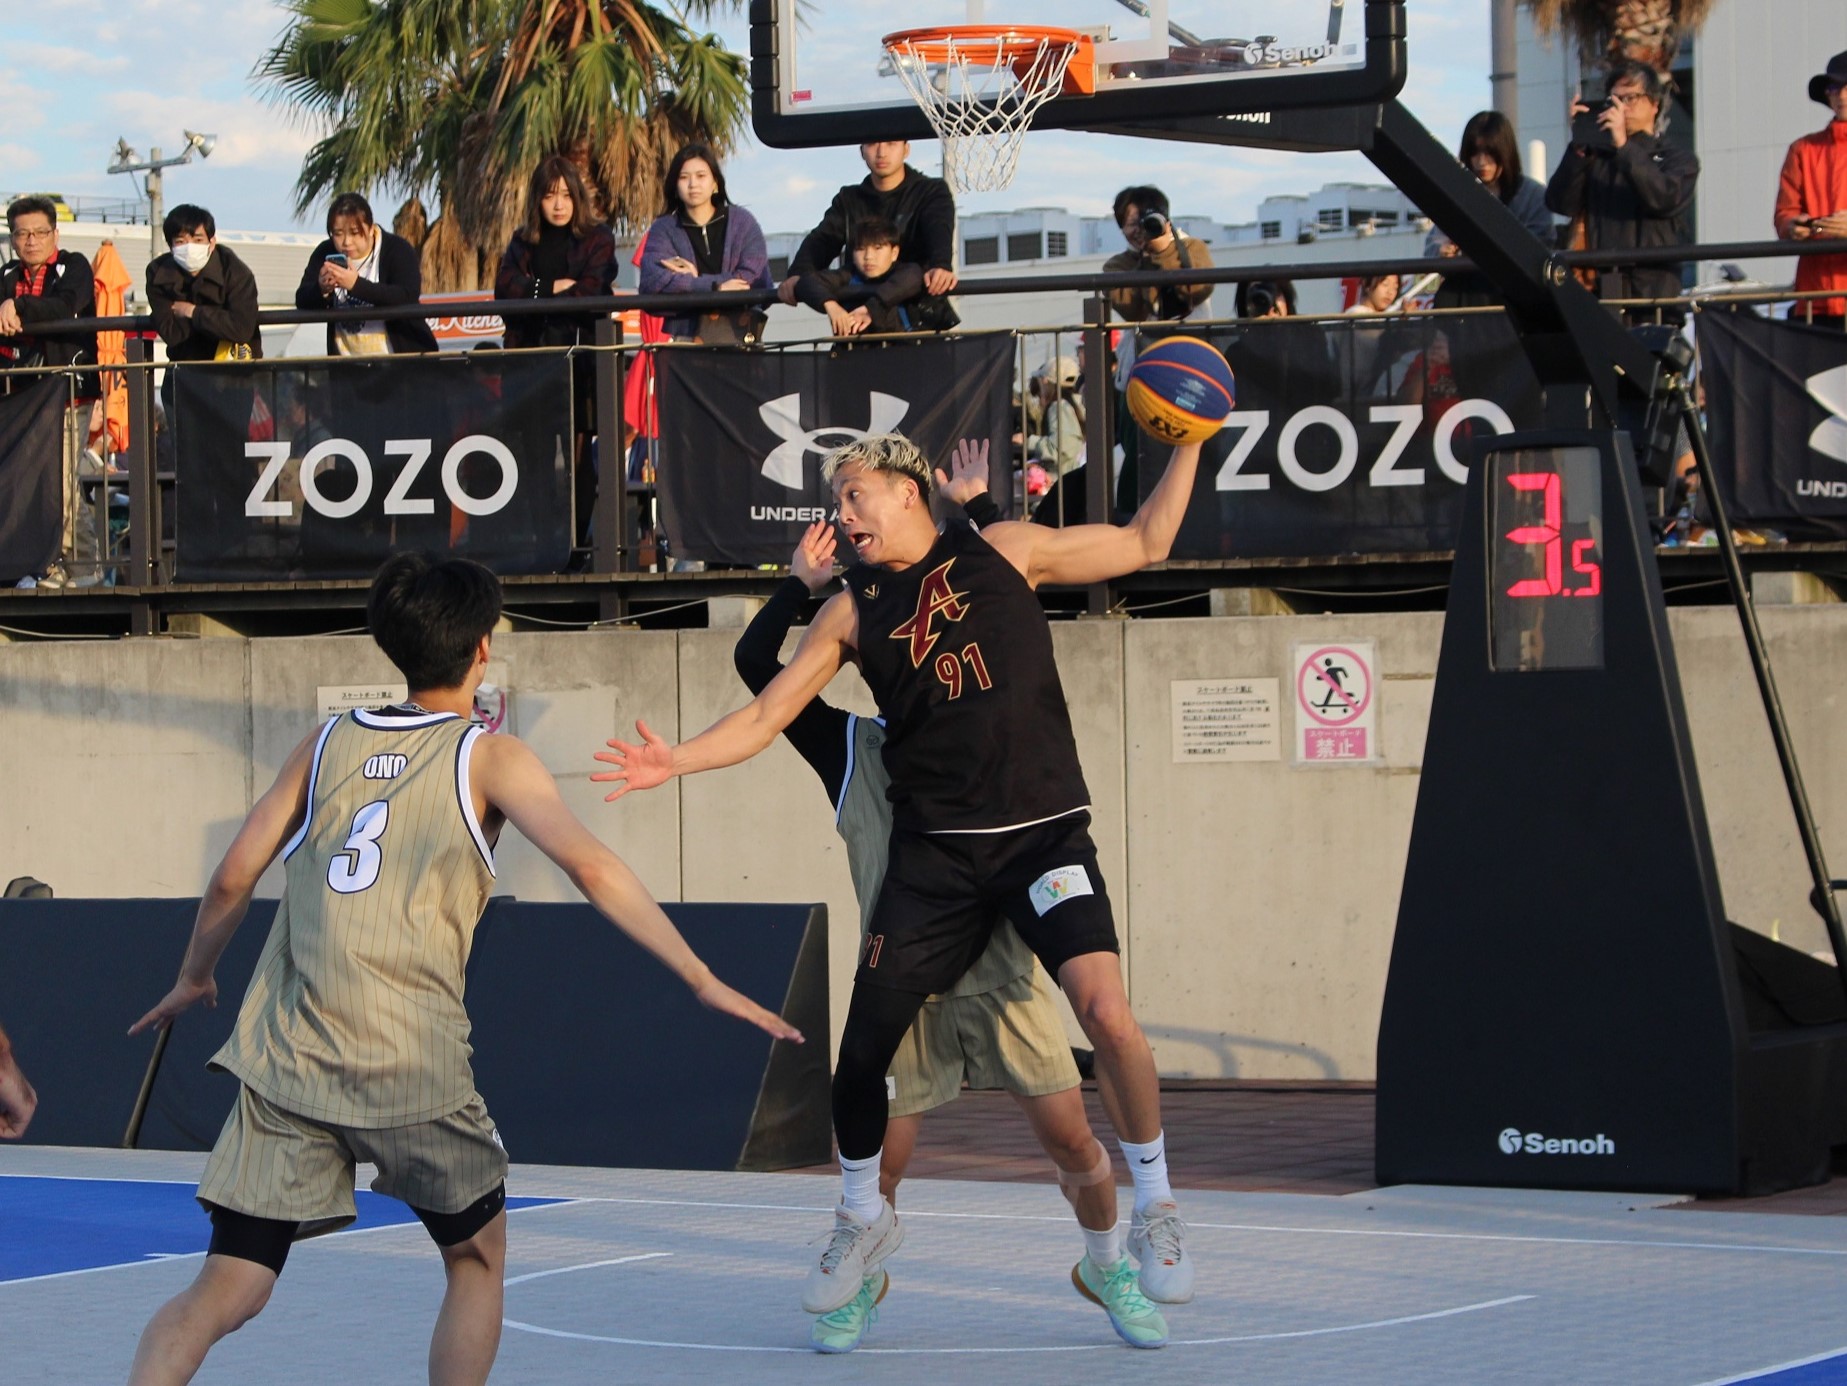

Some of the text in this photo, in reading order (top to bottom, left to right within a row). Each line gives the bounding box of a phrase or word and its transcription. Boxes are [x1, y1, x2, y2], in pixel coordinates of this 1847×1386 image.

[1264, 40, 1338, 62] Senoh
[1216, 398, 1516, 491] ZOZO
[245, 434, 519, 519] ZOZO
[751, 506, 826, 521] UNDER
[1506, 473, 1600, 597] 3.5
[935, 642, 993, 701] 91
[363, 753, 408, 779] ONO
[1316, 737, 1357, 757] 禁止
[327, 800, 389, 894] 3
[1524, 1132, 1615, 1154] Senoh
